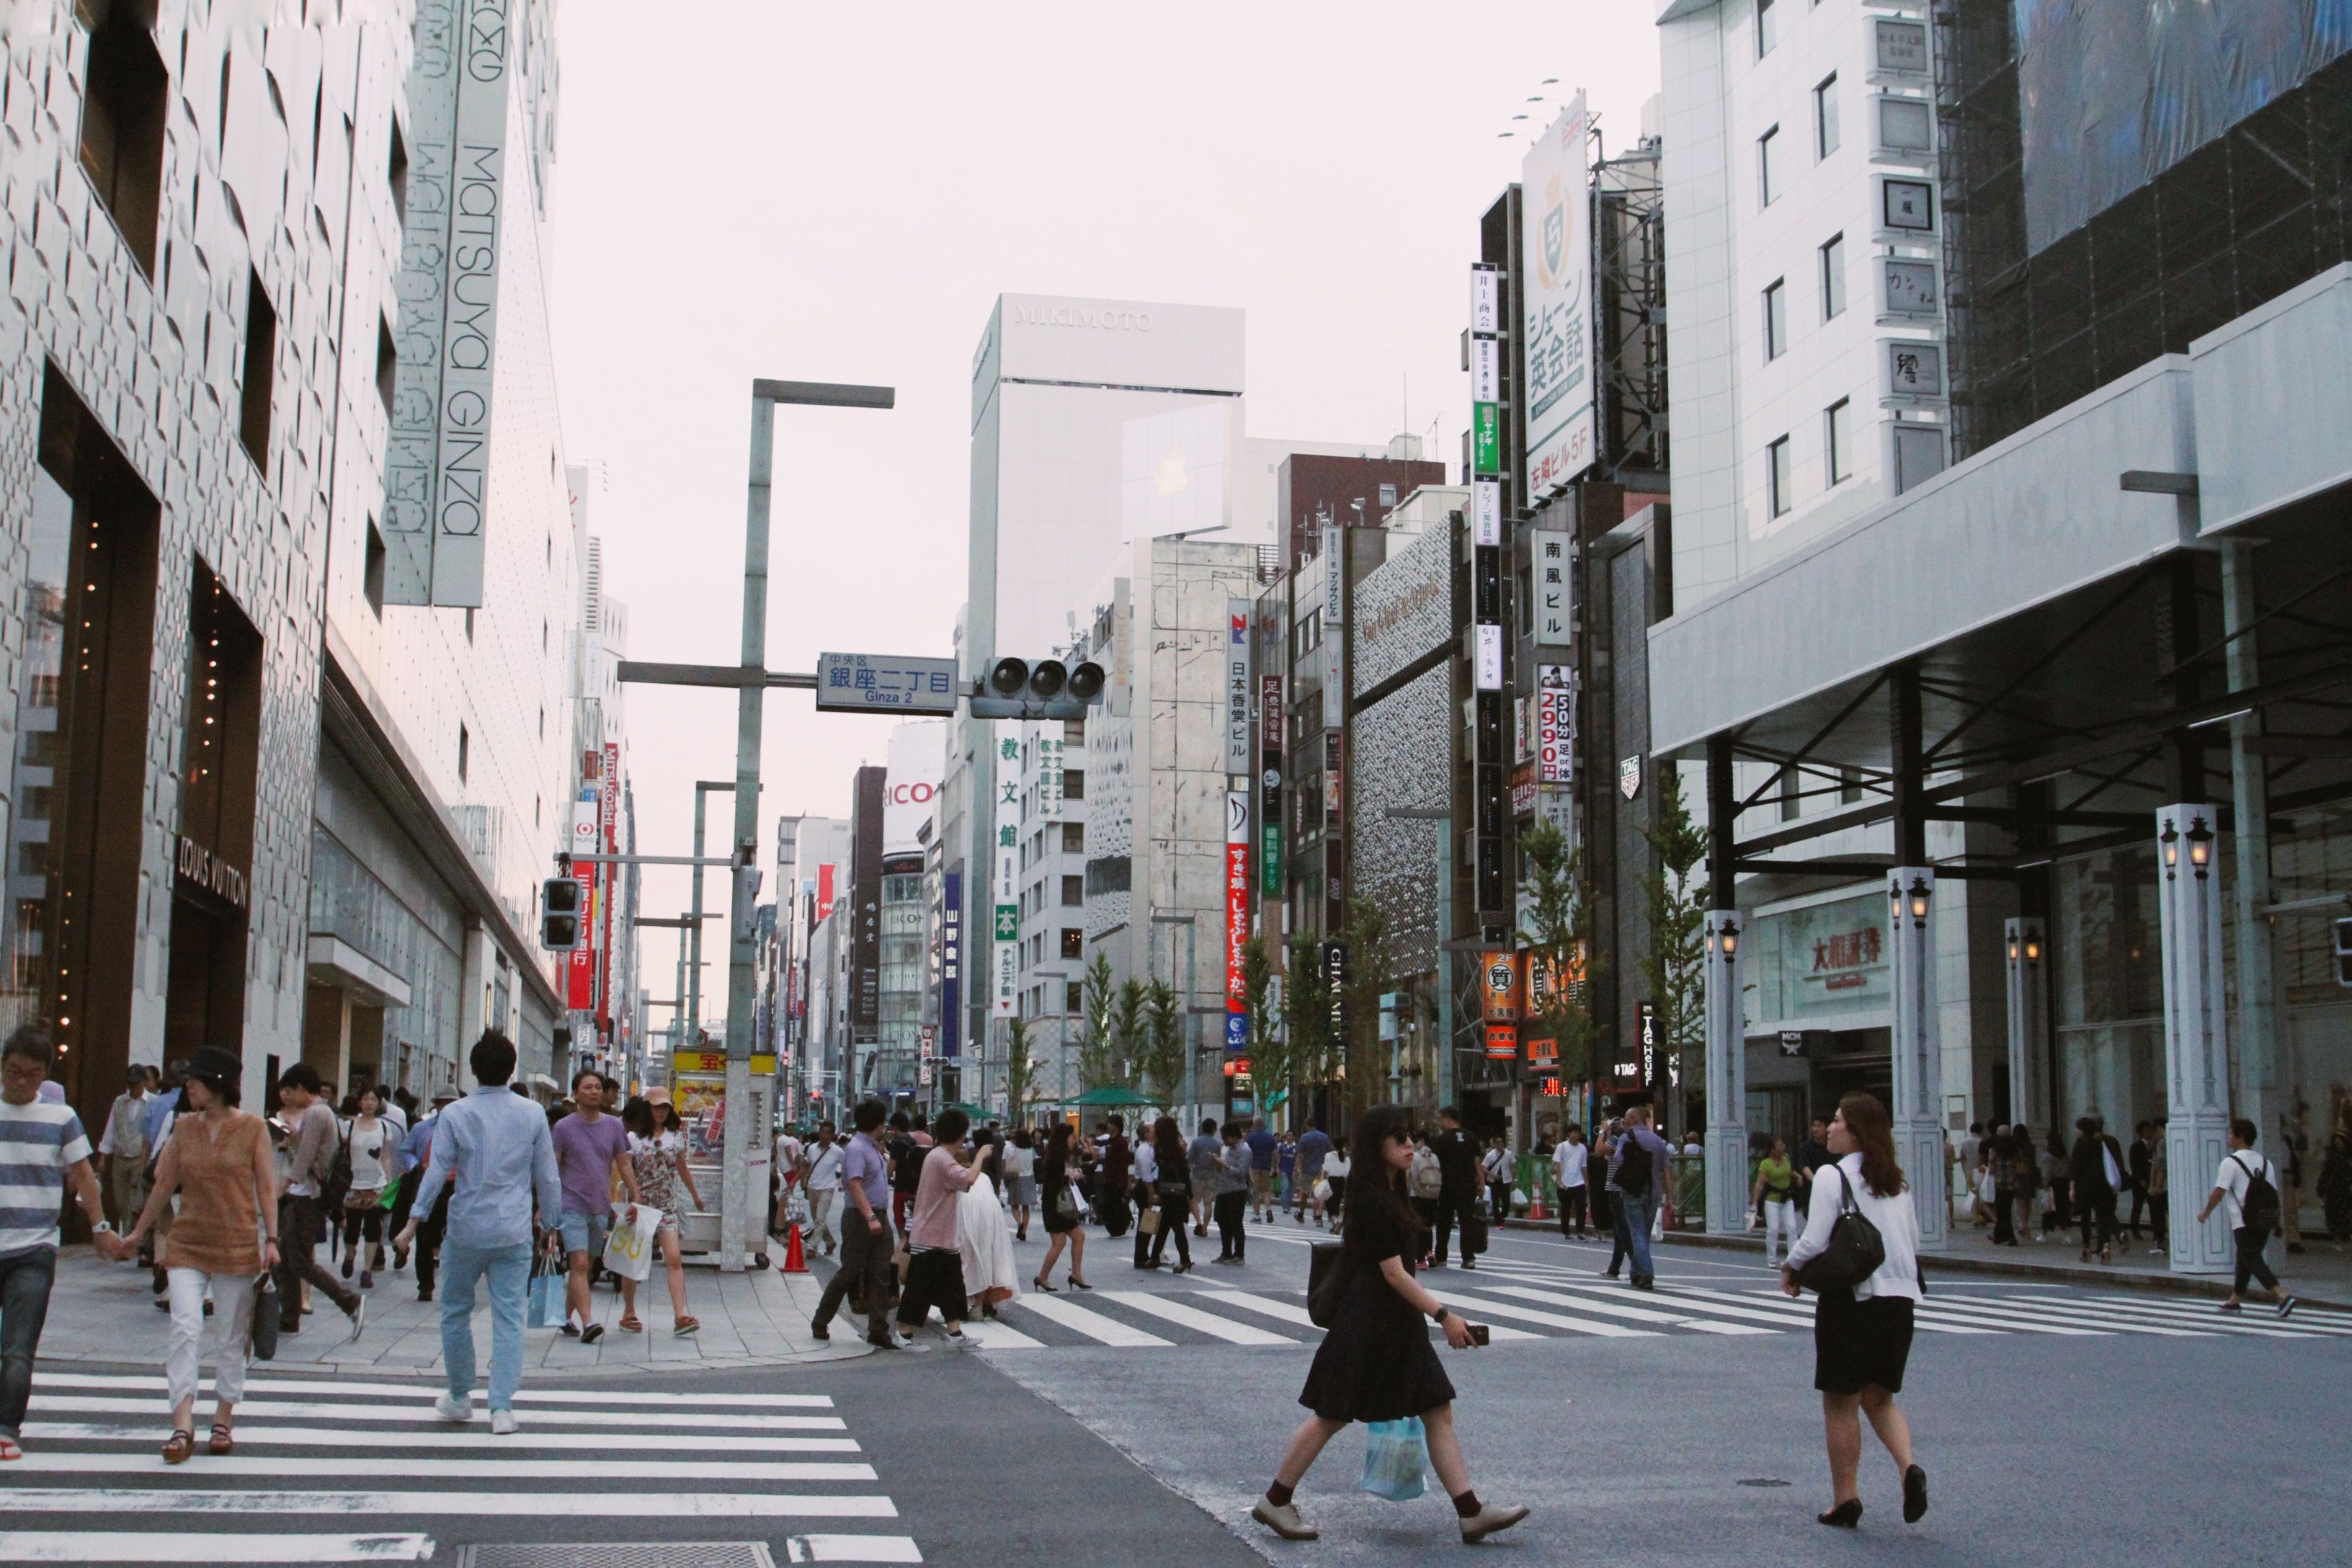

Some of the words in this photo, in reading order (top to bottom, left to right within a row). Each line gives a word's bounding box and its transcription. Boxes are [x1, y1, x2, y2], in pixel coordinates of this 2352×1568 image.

[1015, 306, 1154, 333] MIKIMOTO
[1479, 276, 1490, 327] 井上商会
[1530, 268, 1582, 351] シェーン
[1531, 311, 1583, 399] 英会話
[1545, 542, 1562, 633] 南風ビル
[829, 667, 949, 693] 銀座二丁目
[830, 655, 868, 666] 中央区
[865, 690, 899, 703] Ginza
[904, 692, 912, 703] 2
[1231, 662, 1247, 757] 日本香堂ビル
[1559, 696, 1569, 737] 50分
[1541, 692, 1557, 780] 2990円
[605, 747, 617, 826] MITSUKOSHI
[1041, 739, 1052, 815] 教文館ビル
[1622, 759, 1638, 775] TAG
[1000, 737, 1020, 847] 教文館
[179, 837, 209, 887] LOUIS
[211, 855, 247, 908] VUITTON
[997, 910, 1015, 935] 本
[945, 909, 958, 979] 山野楽器
[1497, 953, 1514, 962] 2F
[1491, 968, 1510, 989] 質
[1643, 1016, 1653, 1045] TAG
[1781, 1032, 1801, 1041] MCM
[611, 1226, 643, 1260] GU
